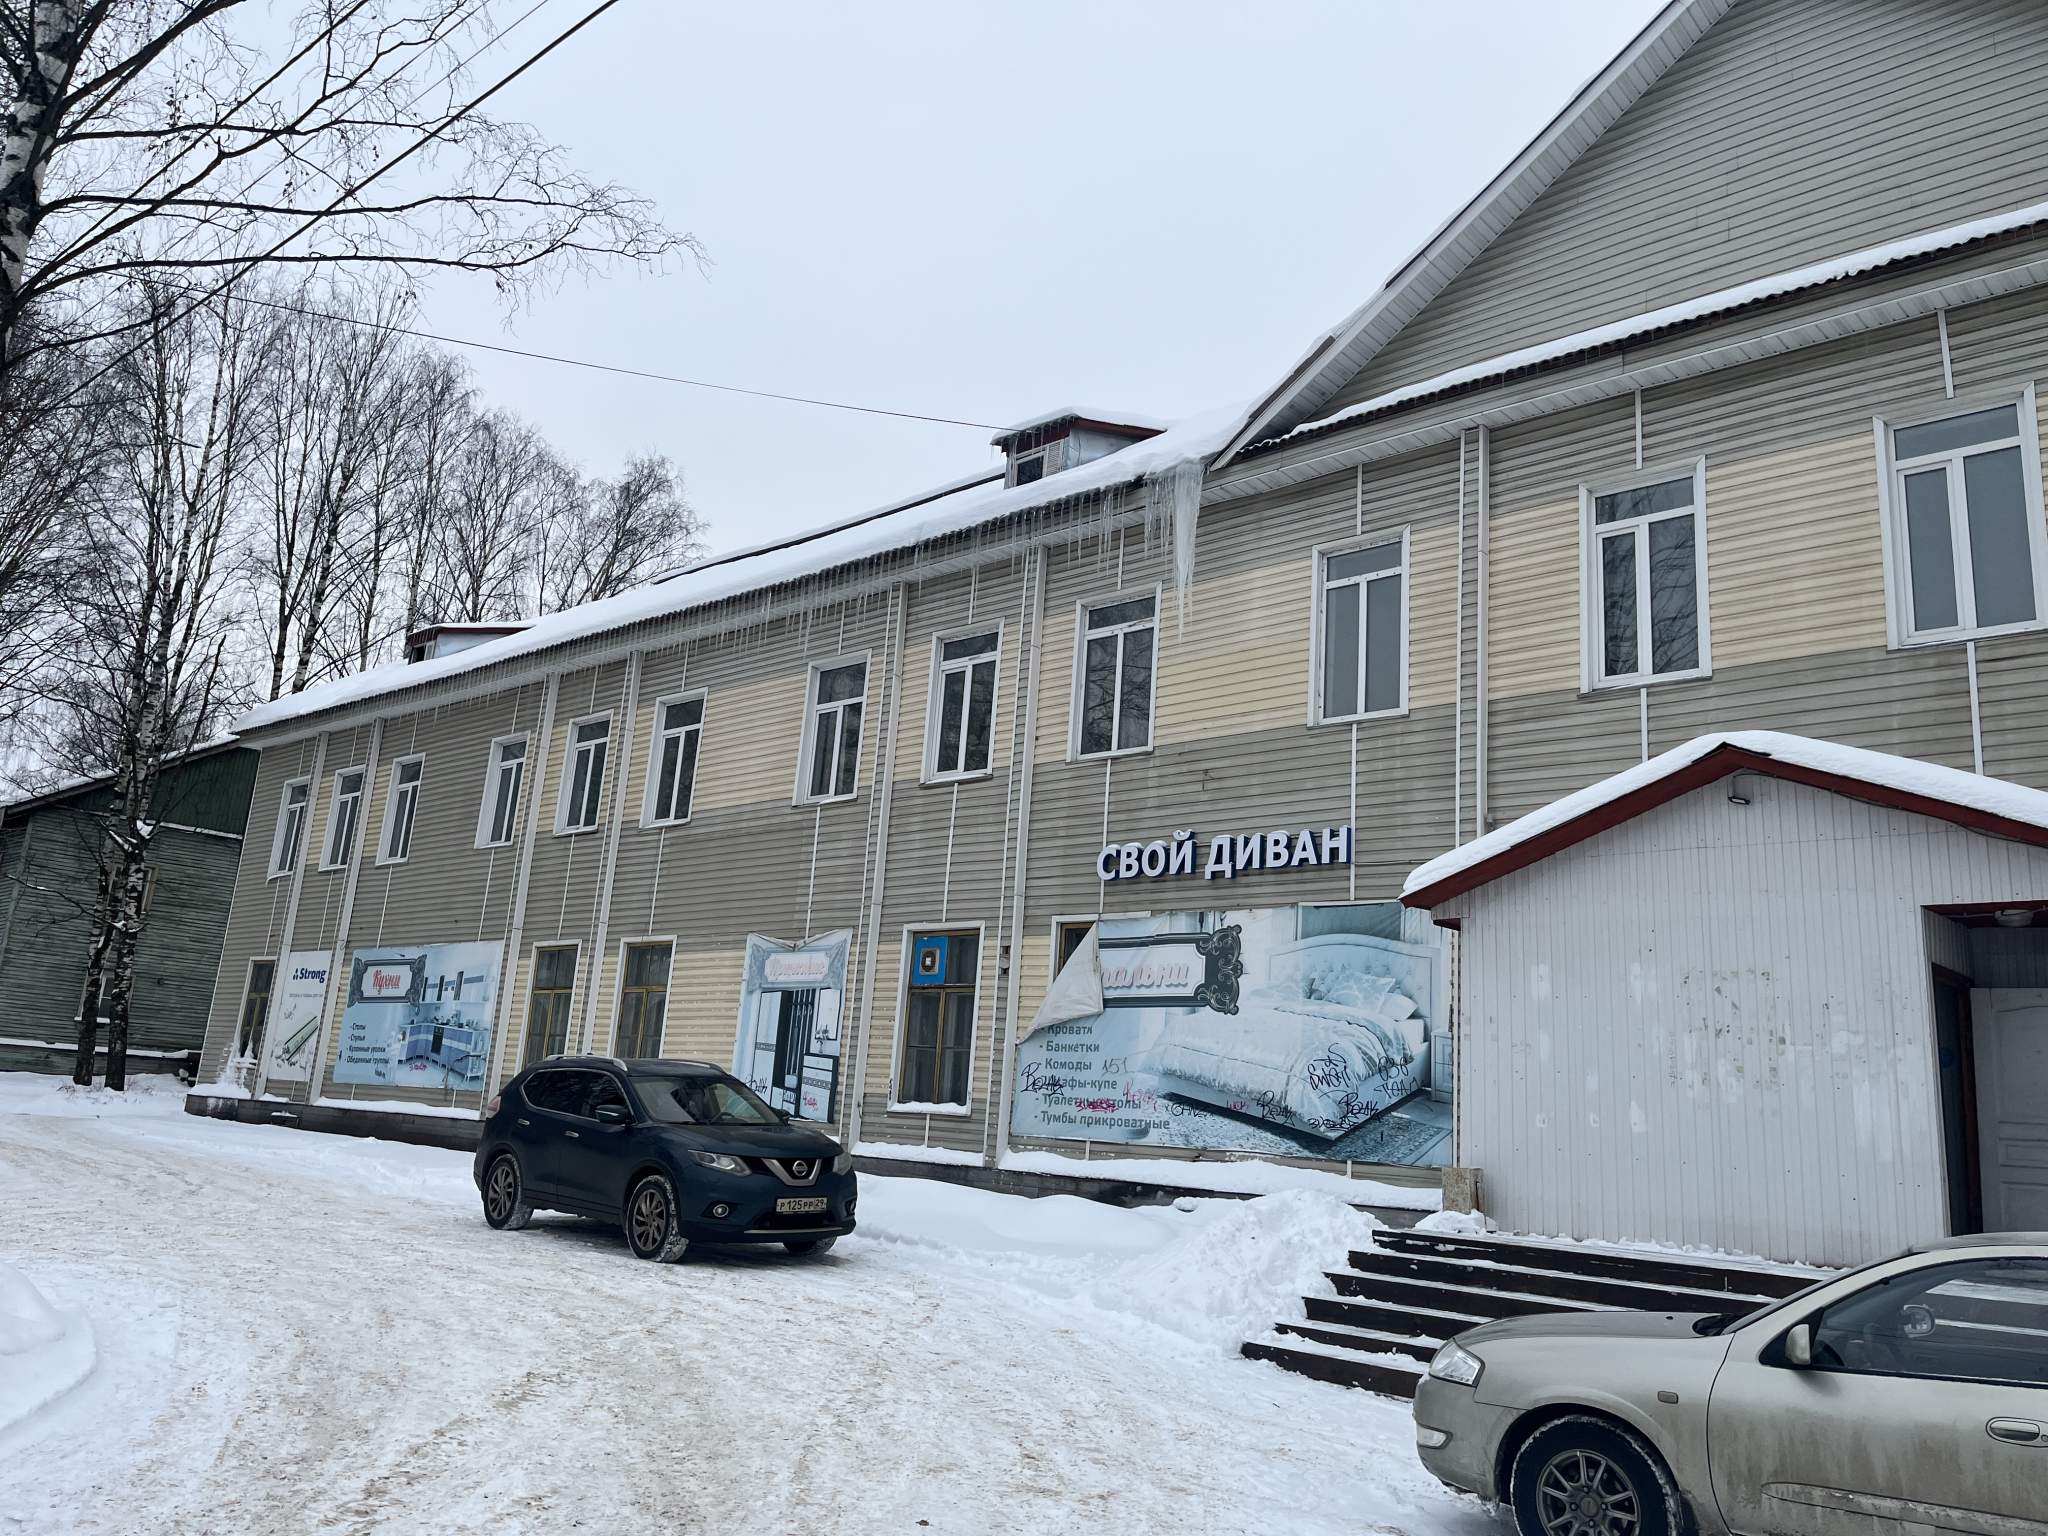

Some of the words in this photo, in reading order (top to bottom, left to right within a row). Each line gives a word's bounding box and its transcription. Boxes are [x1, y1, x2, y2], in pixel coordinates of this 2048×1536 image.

[1097, 829, 1197, 880] СВОЙ
[1205, 825, 1350, 880] ДИВАН
[299, 967, 327, 984] Strong
[372, 968, 401, 995] Кухни
[1046, 1041, 1100, 1053] Банкетки
[1045, 1058, 1092, 1072] Комоды
[1044, 1075, 1117, 1092] афы-купе
[1040, 1110, 1077, 1125] Тумбы
[1079, 1114, 1171, 1130] прикроватные
